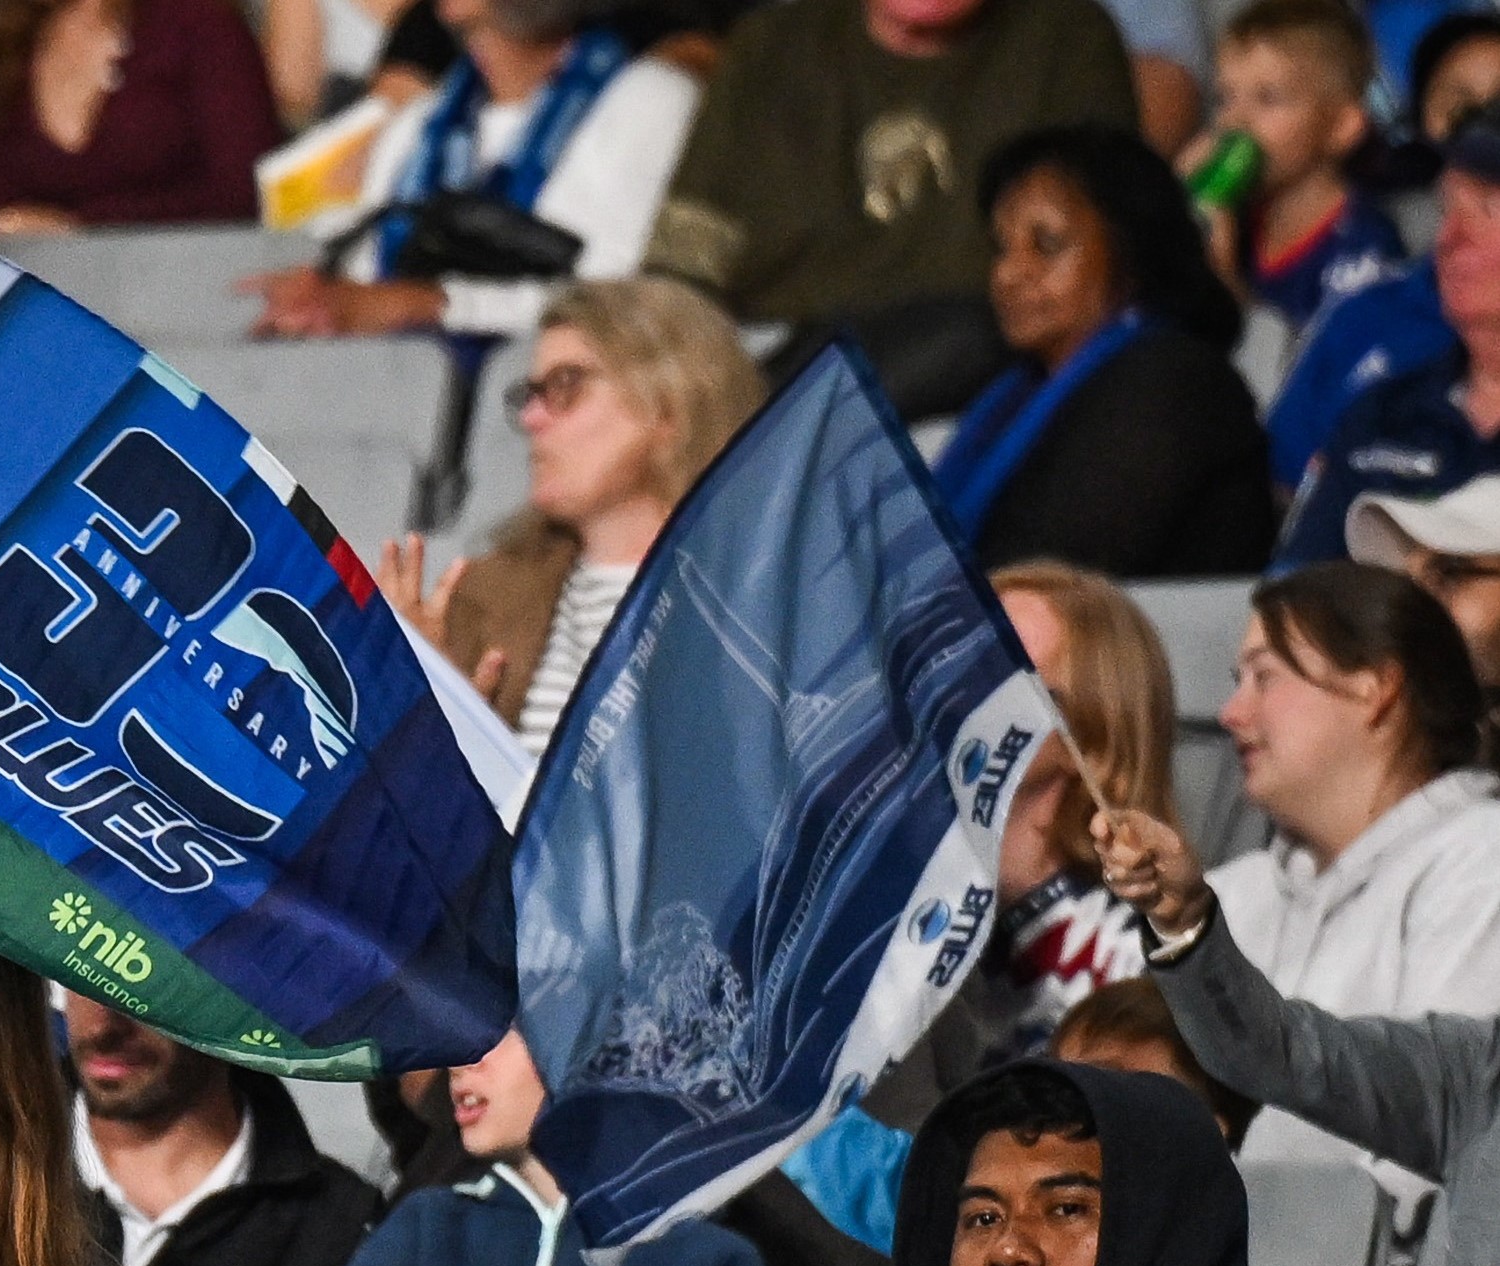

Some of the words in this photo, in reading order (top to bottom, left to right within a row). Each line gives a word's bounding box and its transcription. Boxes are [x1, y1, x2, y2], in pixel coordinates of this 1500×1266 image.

[71, 528, 312, 781] ANNIVERSARY
[62, 950, 149, 1015] Insurance
[77, 920, 153, 983] nib
